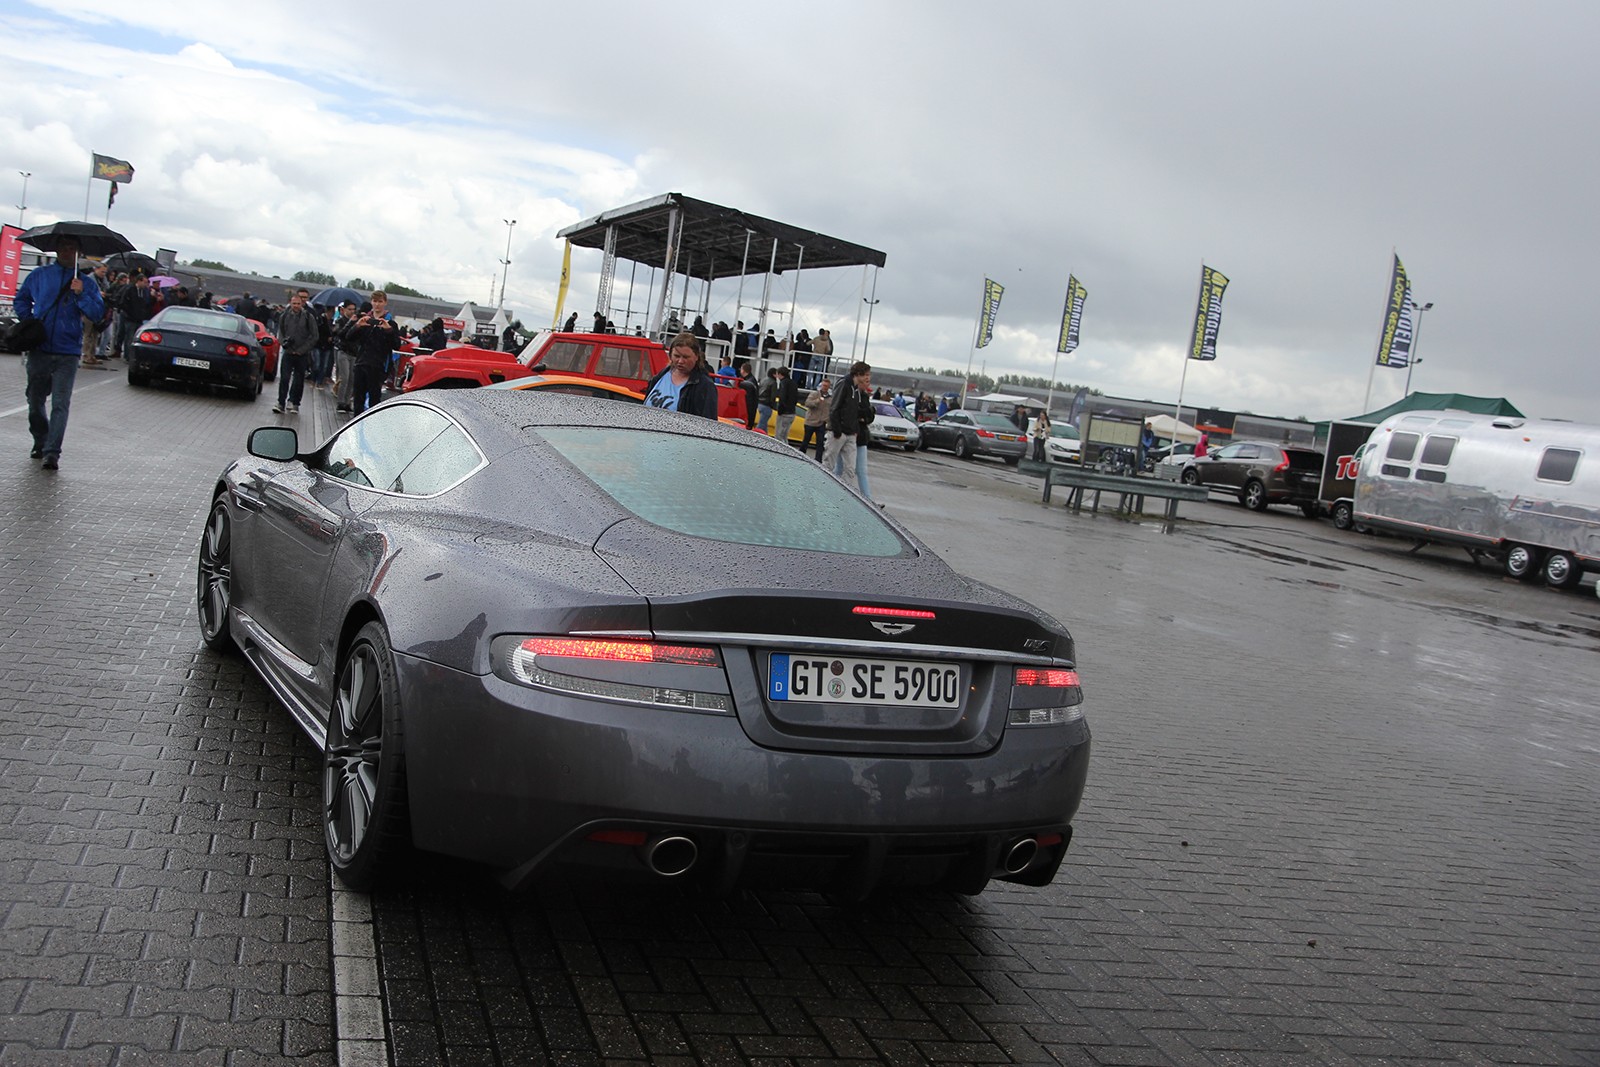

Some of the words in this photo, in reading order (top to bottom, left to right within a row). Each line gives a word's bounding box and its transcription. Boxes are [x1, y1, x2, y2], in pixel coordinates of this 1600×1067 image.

[1199, 285, 1209, 313] LOOPT
[1391, 276, 1405, 311] LOOPT
[775, 681, 783, 692] D
[791, 660, 829, 696] GT
[851, 663, 886, 699] SE
[894, 665, 957, 703] 5900
